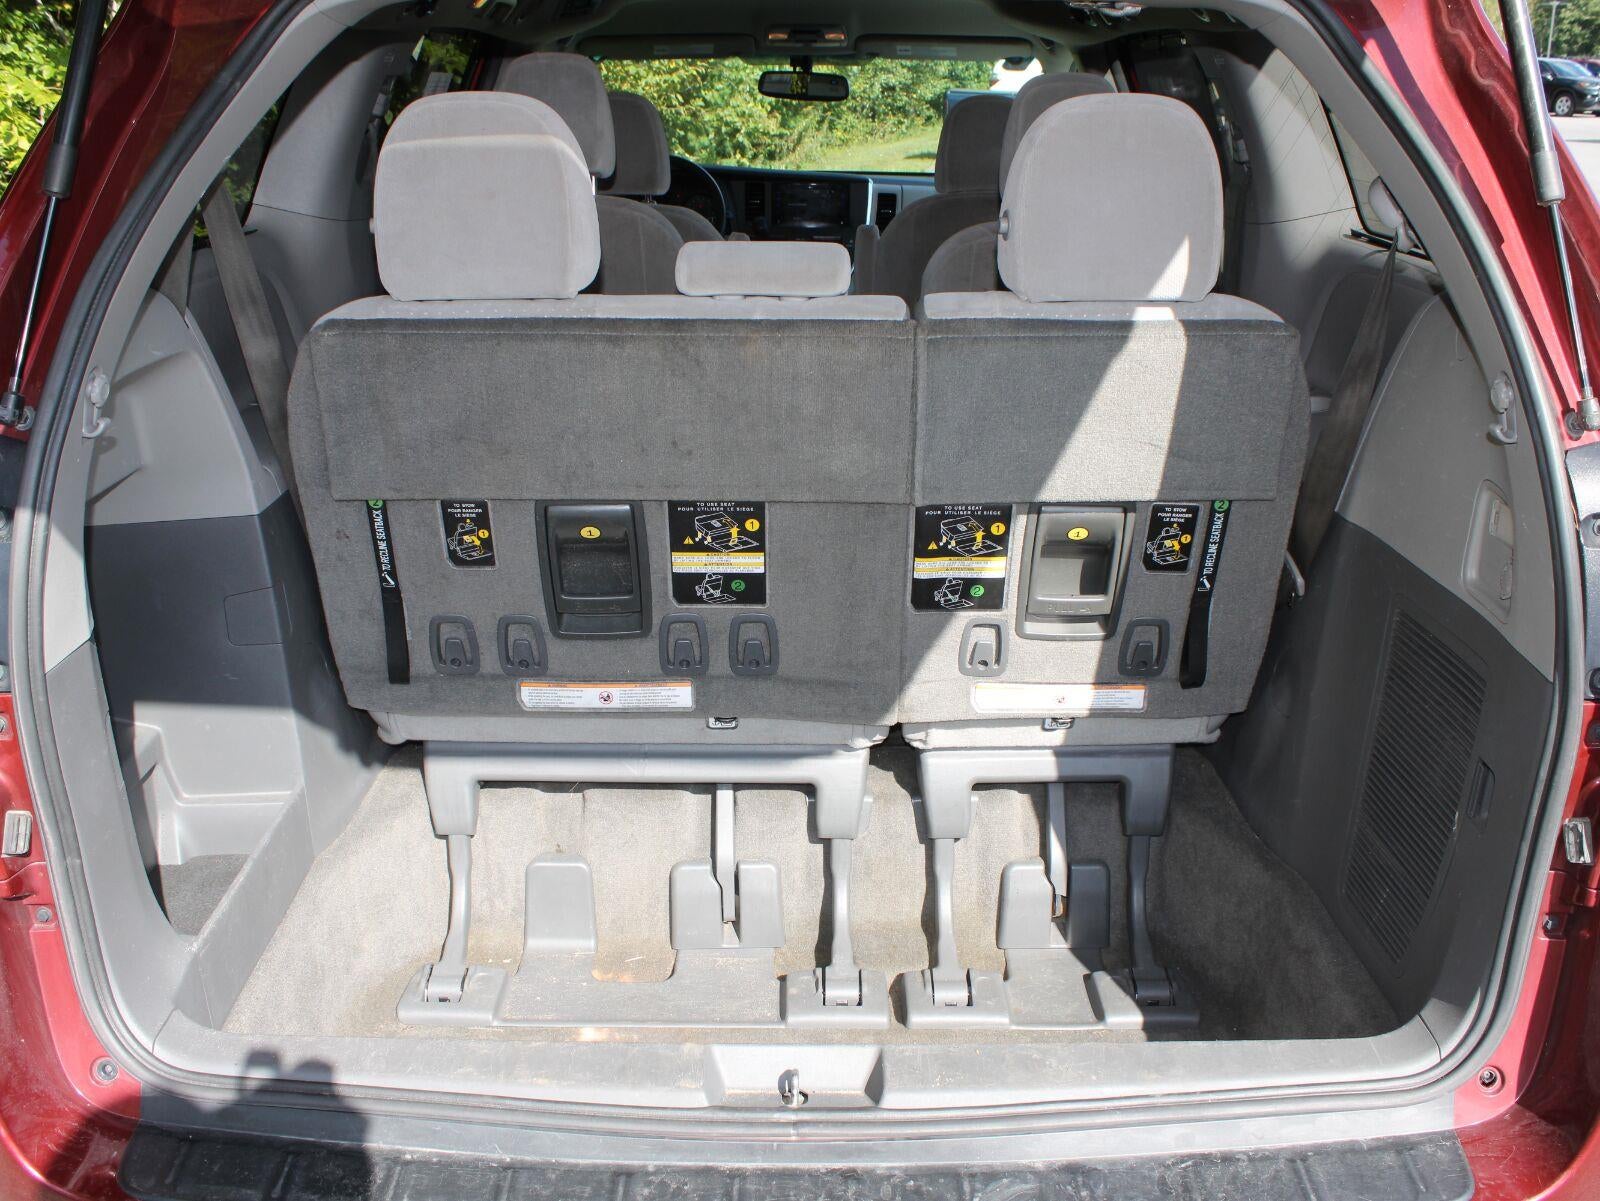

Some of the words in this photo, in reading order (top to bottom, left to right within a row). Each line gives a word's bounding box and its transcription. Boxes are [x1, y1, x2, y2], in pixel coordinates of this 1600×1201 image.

[372, 509, 387, 541] SEATBACK
[1210, 512, 1225, 543] SEATBACK
[377, 540, 390, 564] RECLINE
[1204, 543, 1219, 567] RECLINE
[382, 563, 391, 572] TO
[1203, 566, 1213, 575] TO
